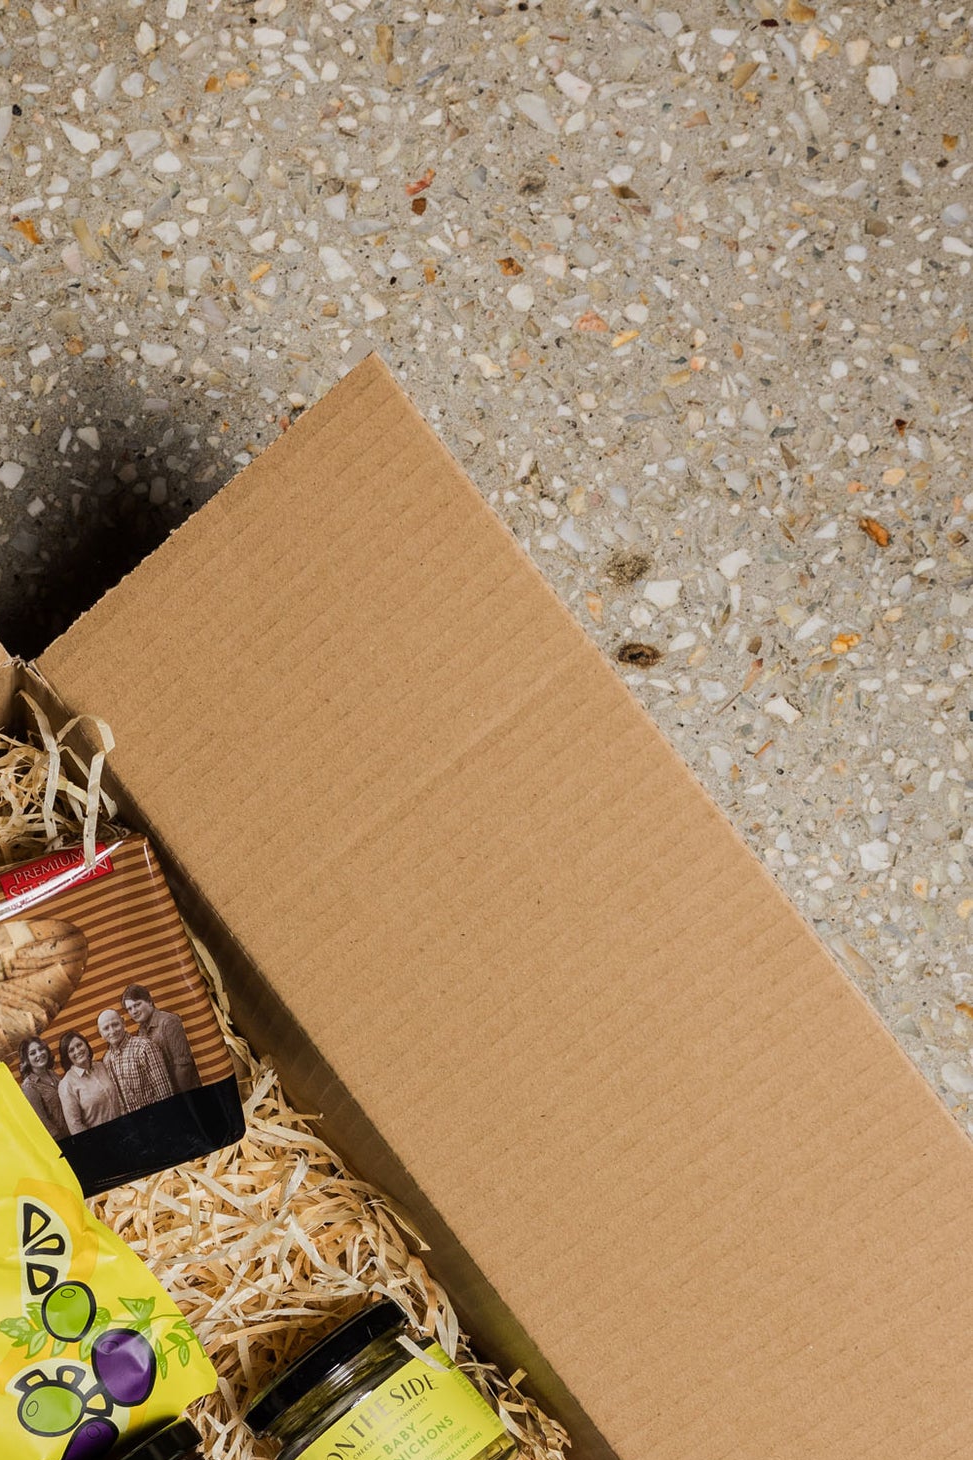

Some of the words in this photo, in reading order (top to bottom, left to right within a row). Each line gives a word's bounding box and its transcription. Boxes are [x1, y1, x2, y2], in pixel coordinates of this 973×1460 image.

[12, 849, 87, 885] PREMIUM
[389, 1372, 440, 1407] SIDE
[382, 1422, 418, 1456] BABY
